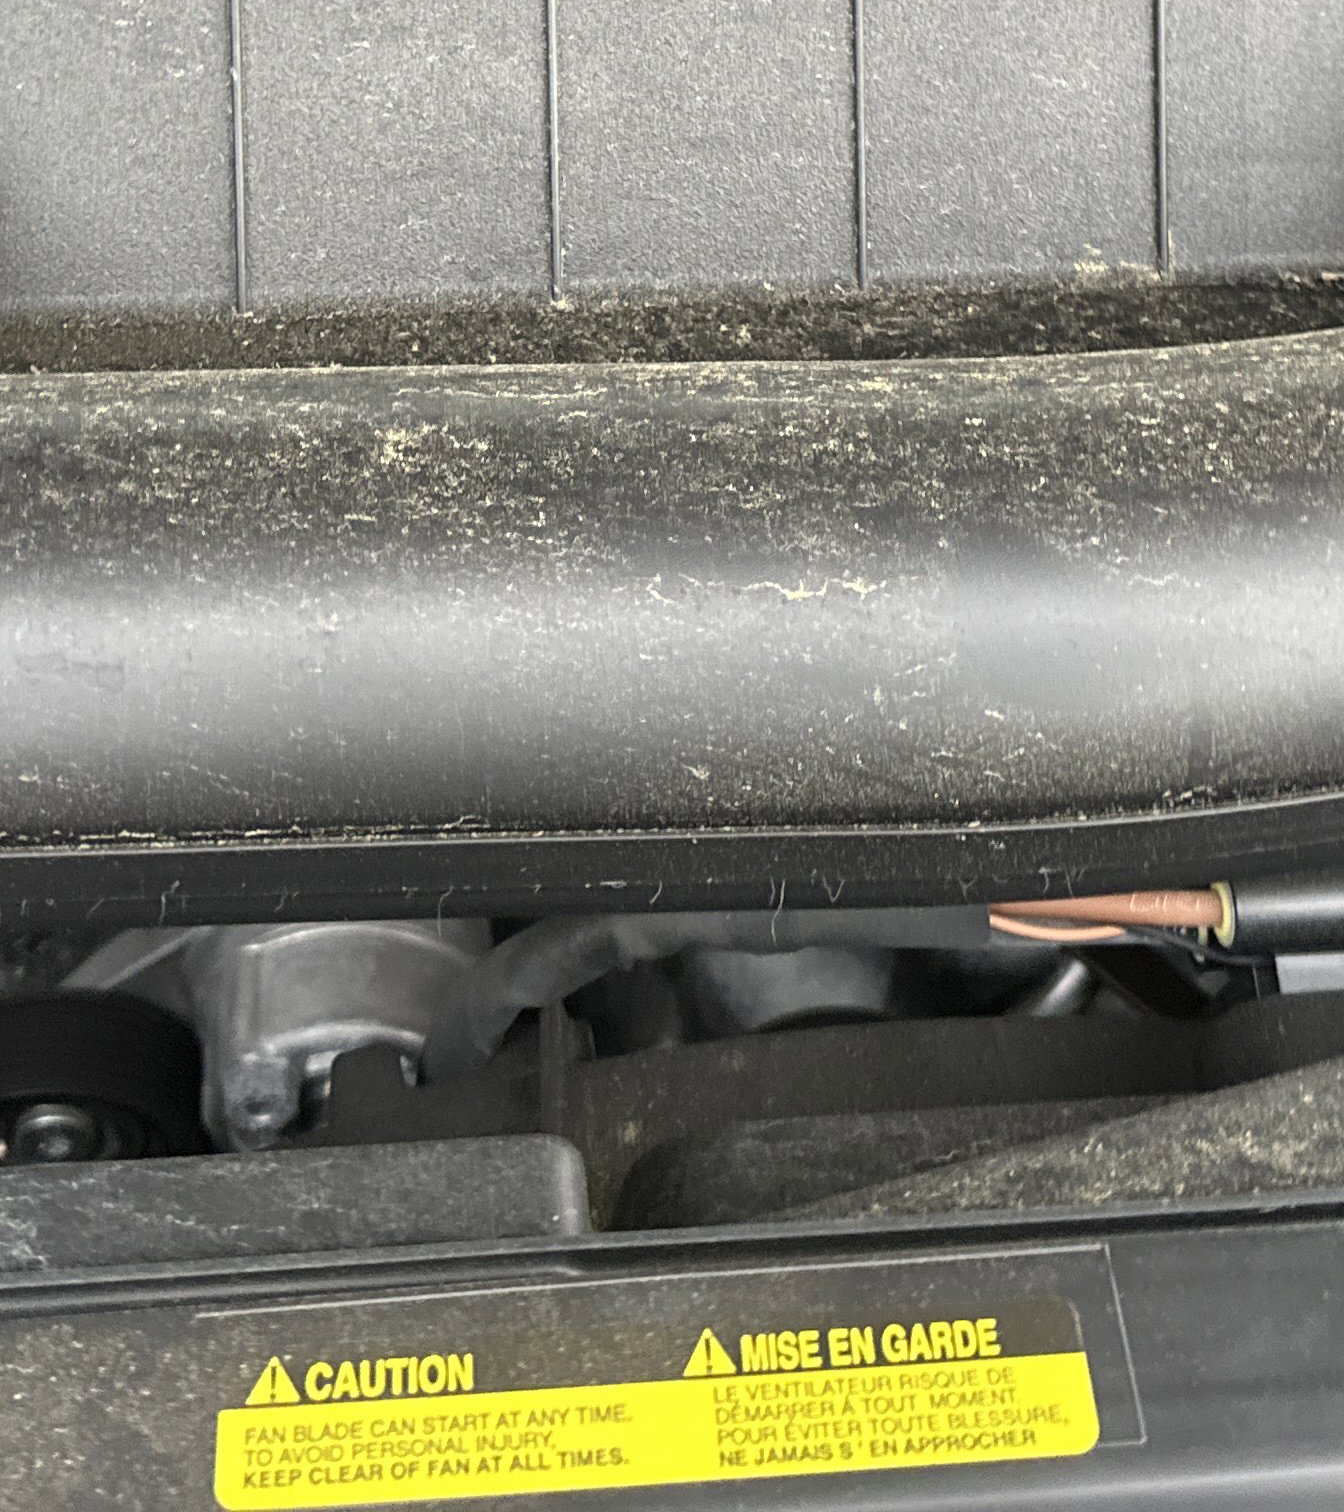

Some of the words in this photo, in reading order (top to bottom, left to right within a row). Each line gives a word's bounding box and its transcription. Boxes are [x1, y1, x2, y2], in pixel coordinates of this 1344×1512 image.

[739, 1329, 823, 1373] MISE
[828, 1326, 877, 1367] EN
[881, 1318, 1001, 1363] GARDE
[305, 1352, 474, 1400] CAUTION
[713, 1385, 737, 1404] LE
[745, 1375, 893, 1401] VENTILATEUR
[899, 1367, 980, 1390] RISQUE
[986, 1366, 1015, 1385] DE
[244, 1427, 287, 1445] FAN
[293, 1420, 363, 1443] BLADE
[370, 1417, 415, 1437] CAN
[422, 1413, 490, 1435] START
[496, 1410, 521, 1430] AT
[526, 1407, 570, 1427] ANY
[576, 1403, 633, 1424] TIME.
[715, 1400, 834, 1425] DÉMARRER
[862, 1393, 916, 1414] TOUT
[717, 1426, 777, 1446] POUR
[784, 1417, 862, 1441] ÉVITER
[869, 1413, 941, 1435] TOUTE
[947, 1403, 1070, 1430] BLESSURE,
[242, 1469, 302, 1489] KEEP
[308, 1464, 384, 1485] CLEAR
[390, 1460, 420, 1480] OF
[427, 1458, 470, 1477] FAN
[476, 1455, 503, 1474] AT
[509, 1452, 552, 1472] ALL
[557, 1447, 630, 1469] TIMES.
[243, 1449, 273, 1467] TO
[279, 1444, 344, 1465] AVOID
[352, 1437, 469, 1460] PERSONAL
[476, 1430, 556, 1452] INJURY,
[719, 1449, 748, 1468] NE
[754, 1443, 833, 1466] JAMAIS
[904, 1428, 1037, 1455] APPROCHER
